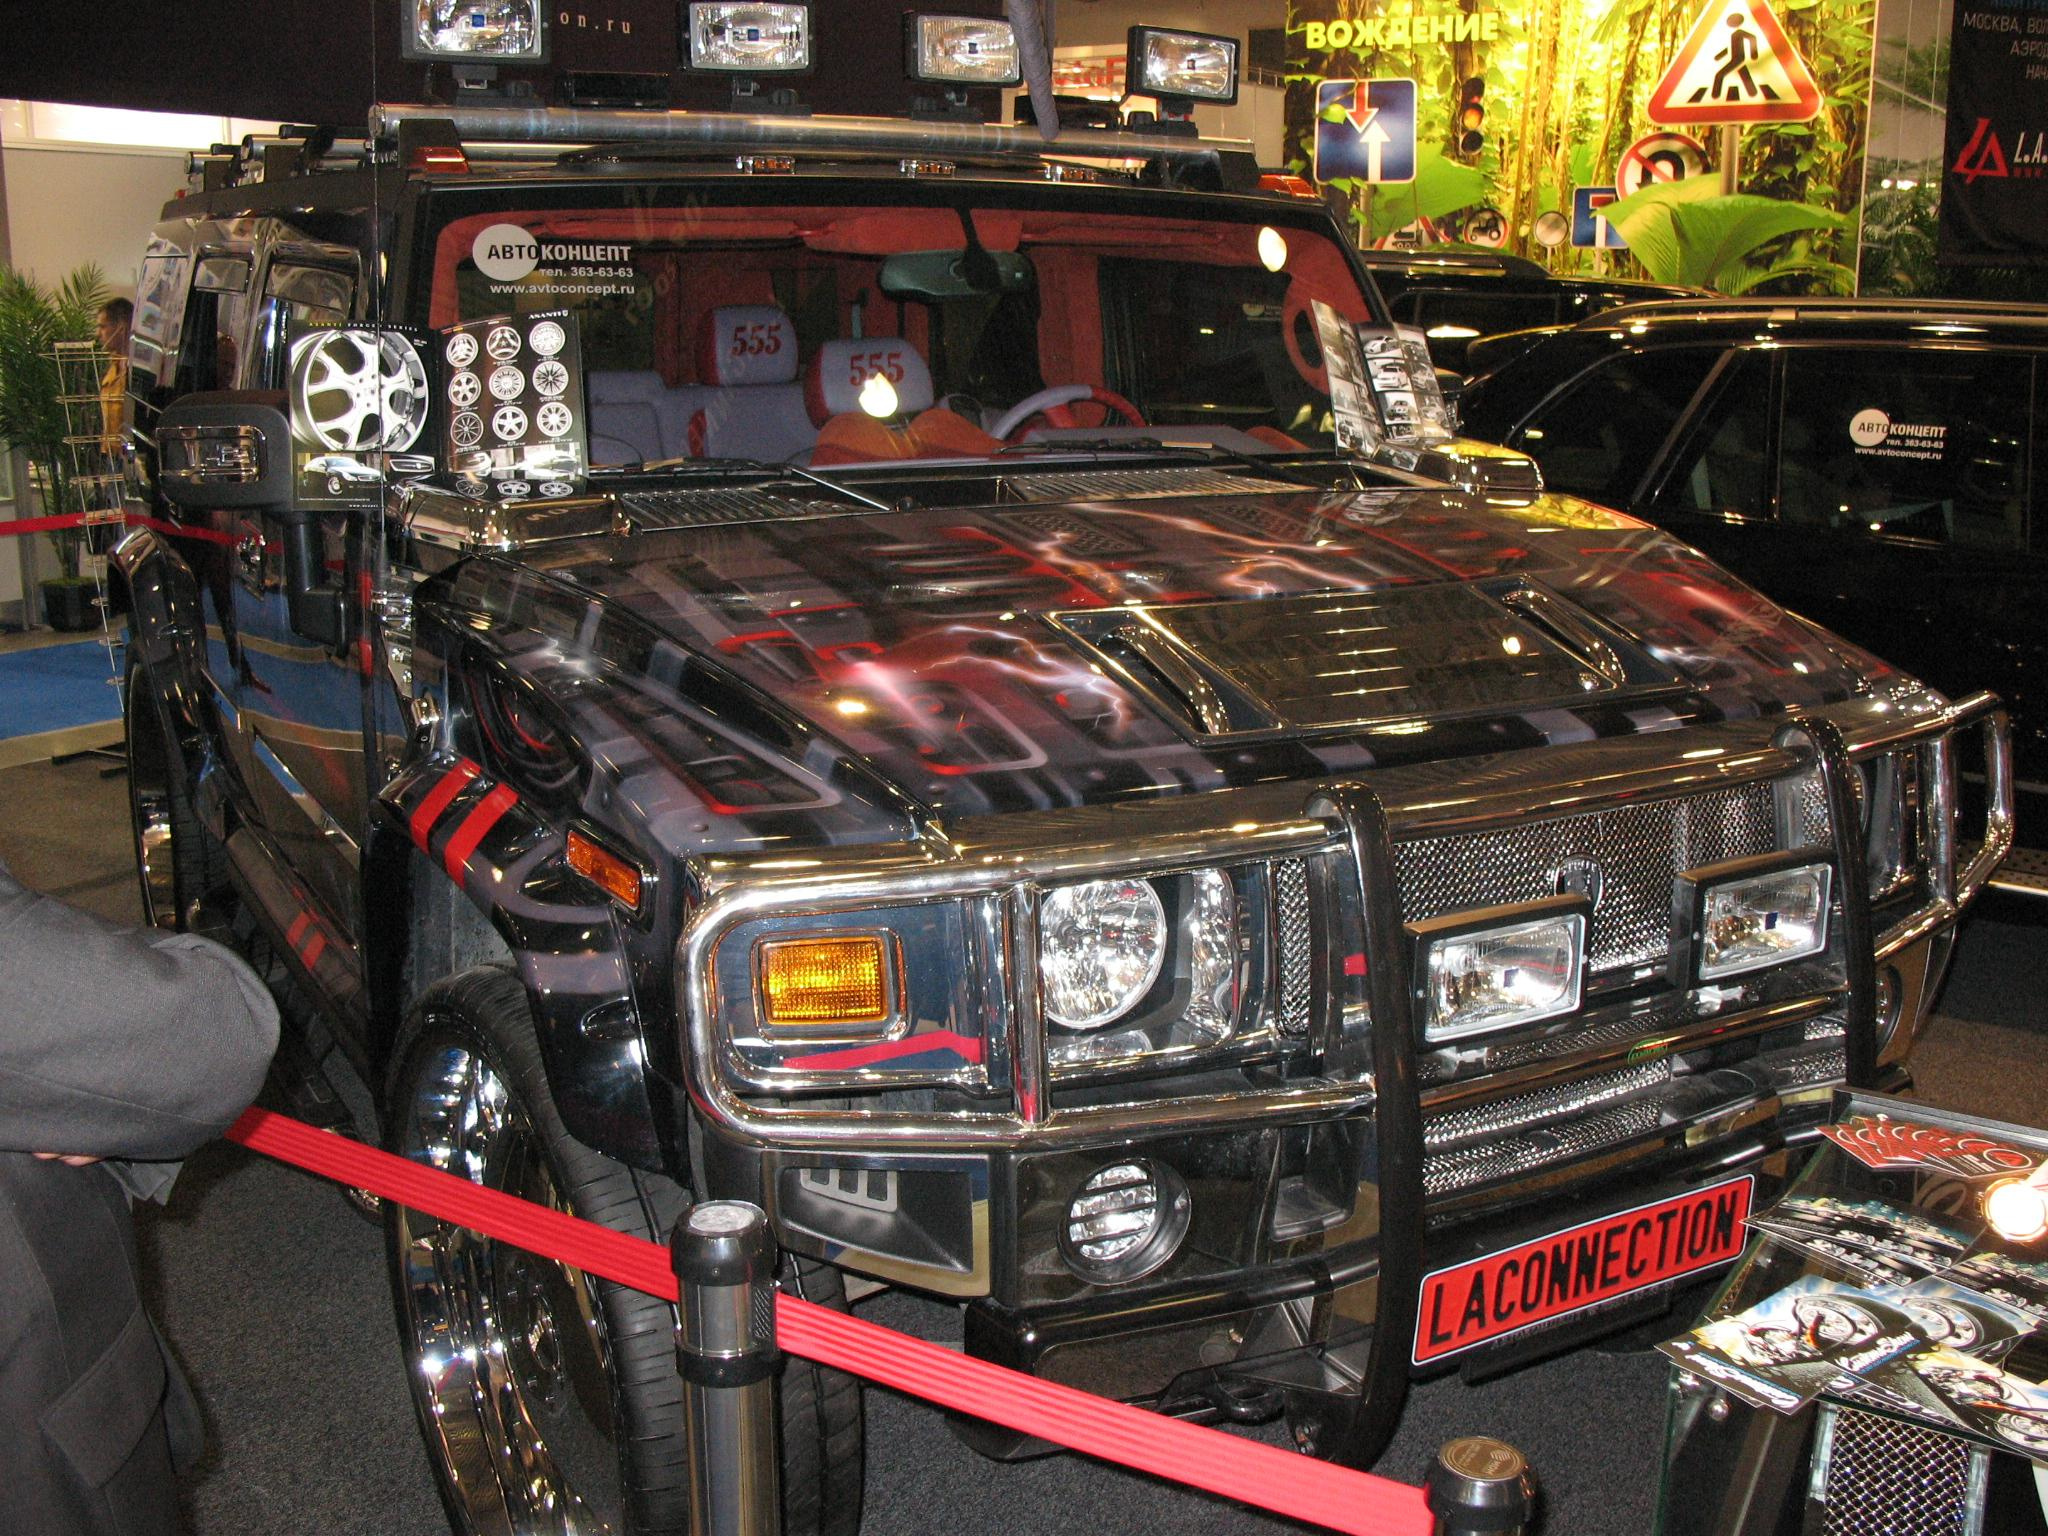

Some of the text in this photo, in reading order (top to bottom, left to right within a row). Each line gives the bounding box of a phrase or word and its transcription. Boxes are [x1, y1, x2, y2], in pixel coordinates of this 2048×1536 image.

[1306, 12, 1499, 49] ВОЖДЕНИЕ
[1963, 12, 2022, 34] МОСКВА,
[488, 244, 631, 262] АВТОКОНЦЕПТ
[539, 266, 634, 278] тел. 363-63-63
[490, 283, 635, 296] www.avtoconcept.ru
[528, 311, 561, 320] ASANTI
[731, 325, 782, 356] 555
[850, 352, 904, 387] 555
[1858, 422, 1947, 438] АВТОКОНЦЕПТ
[1904, 439, 1944, 449] 363-63-63
[1855, 447, 1942, 460] www.avtoconcept.ru
[1429, 1189, 1739, 1348] LACONNECTION
